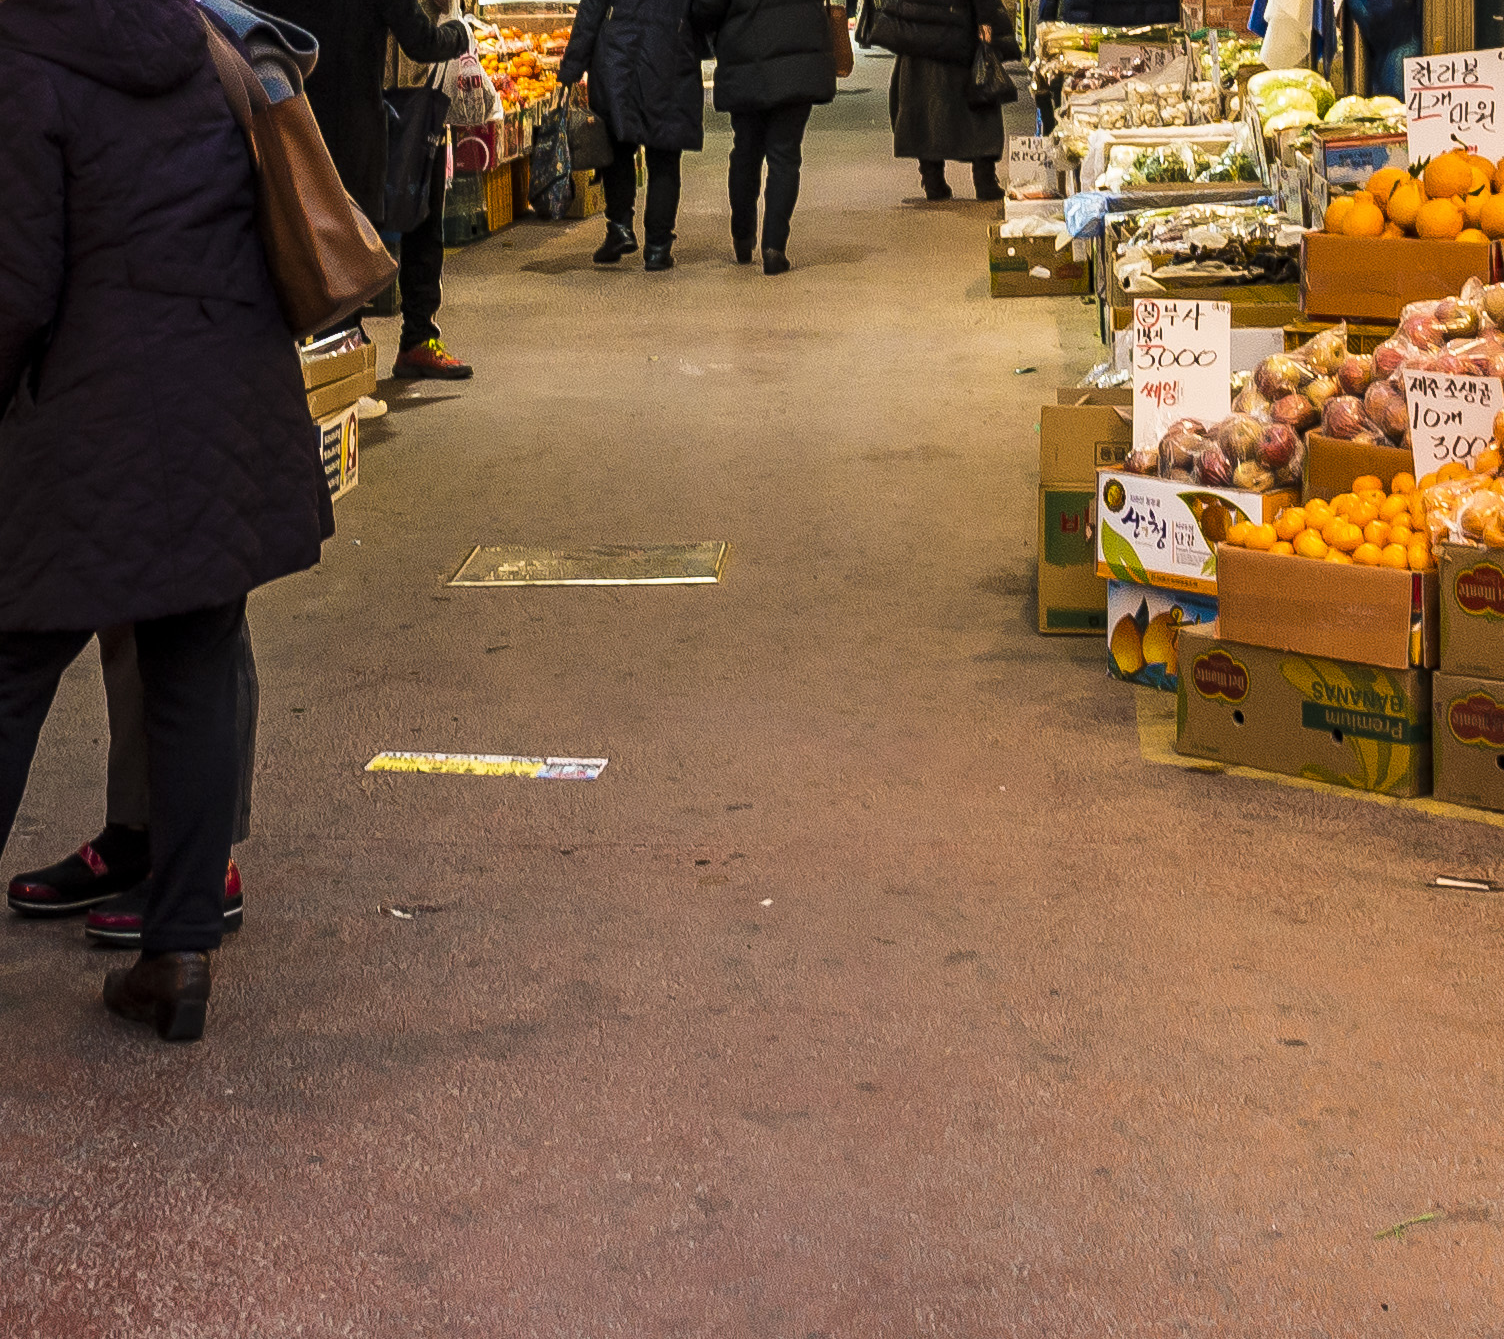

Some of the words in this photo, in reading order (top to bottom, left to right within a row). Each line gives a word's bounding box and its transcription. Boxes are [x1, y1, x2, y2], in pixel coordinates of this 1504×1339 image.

[1410, 57, 1479, 88] 한라봉
[1408, 91, 1451, 120] 4개
[1449, 99, 1496, 133] 만원
[1162, 301, 1206, 333] 부사
[1135, 345, 1218, 372] 3,000
[1408, 376, 1442, 398] 제주
[1412, 401, 1464, 431] 10개
[1312, 682, 1404, 710] BANANAS
[1323, 708, 1404, 740] Premium
